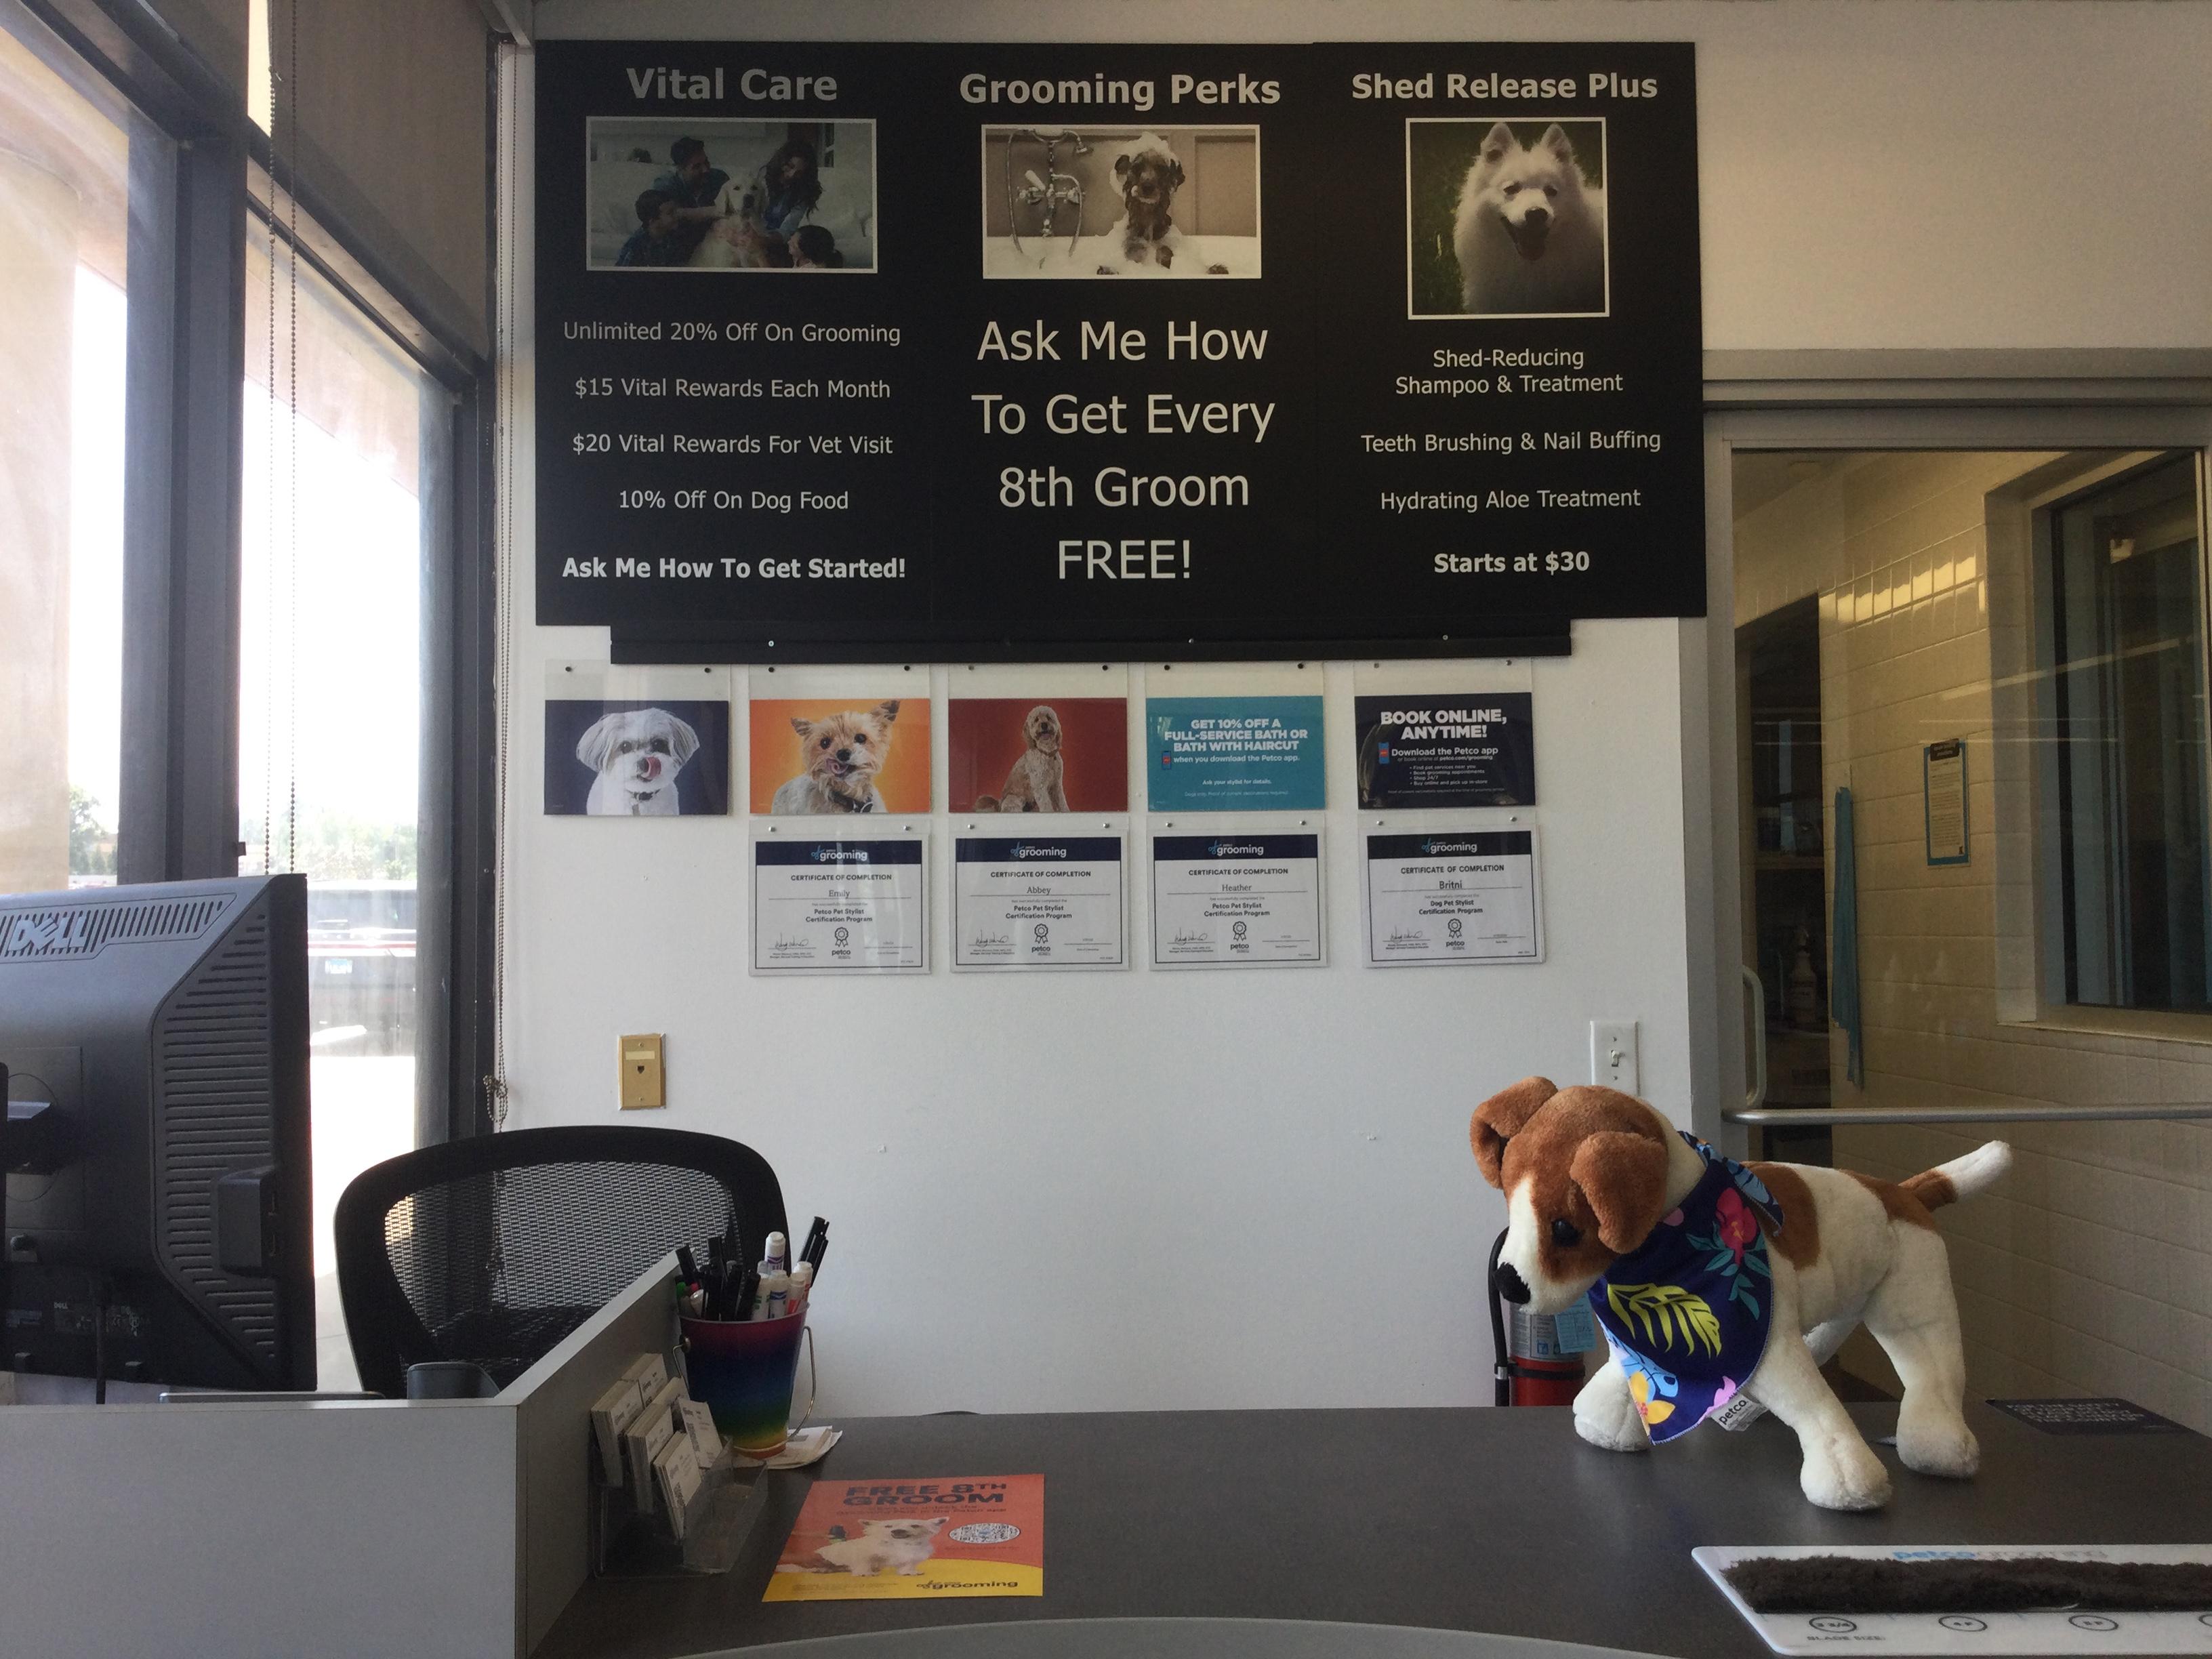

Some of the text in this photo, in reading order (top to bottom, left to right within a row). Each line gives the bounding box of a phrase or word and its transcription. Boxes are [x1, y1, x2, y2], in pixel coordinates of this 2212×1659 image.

[626, 67, 837, 100] Vital Care
[960, 73, 1280, 111] Grooming Perks
[1353, 73, 1657, 98] Shed Release Plus
[565, 321, 900, 346] Unlimited 20% Off On Grooming
[977, 320, 1267, 361] Ask Me How
[1434, 348, 1583, 369] Shed-Reducing
[575, 377, 890, 398] $15 Vital Rewards Each Month
[1396, 375, 1623, 397] Shampoo & Treatment
[972, 394, 1275, 443] To Get Every
[573, 433, 893, 455] $20 Vital Rewards For Vet Visit
[1361, 430, 1660, 454] Teeth Brushing & Nail Buffing
[1000, 466, 1248, 507] 8th Groom
[620, 491, 848, 513] 10% Off On Dog Food
[1382, 489, 1641, 514] Hydrating Aloe Treatment
[562, 557, 905, 577] Ask Me How To Get Started!
[1059, 540, 1189, 579] FREE!
[1435, 551, 1589, 575] Starts at $30
[1191, 718, 1281, 729] GET 10% OFF A
[1381, 709, 1507, 726] BOOK ONLINE,
[1164, 729, 1308, 741] FULL-SERVICE BATH OR
[1401, 725, 1487, 739] ANYTIME!
[1173, 741, 1299, 752] BATH WITH HAIRCUT
[1391, 747, 1435, 756] Download
[1437, 747, 1452, 756] the
[1481, 747, 1498, 756] app
[820, 849, 867, 861] grooming
[1019, 846, 1067, 859] grooming
[1217, 844, 1264, 857] grooming
[1431, 842, 1477, 855] grooming
[829, 890, 851, 899] Emily
[1026, 886, 1051, 896] Abbey
[1222, 884, 1252, 892] Heather
[1439, 880, 1462, 889] Britni
[8, 916, 88, 951] DELL
[1718, 1399, 1747, 1425] petco
[843, 1493, 1003, 1506] GROOM
[846, 1483, 1006, 1496] FREE 8TH
